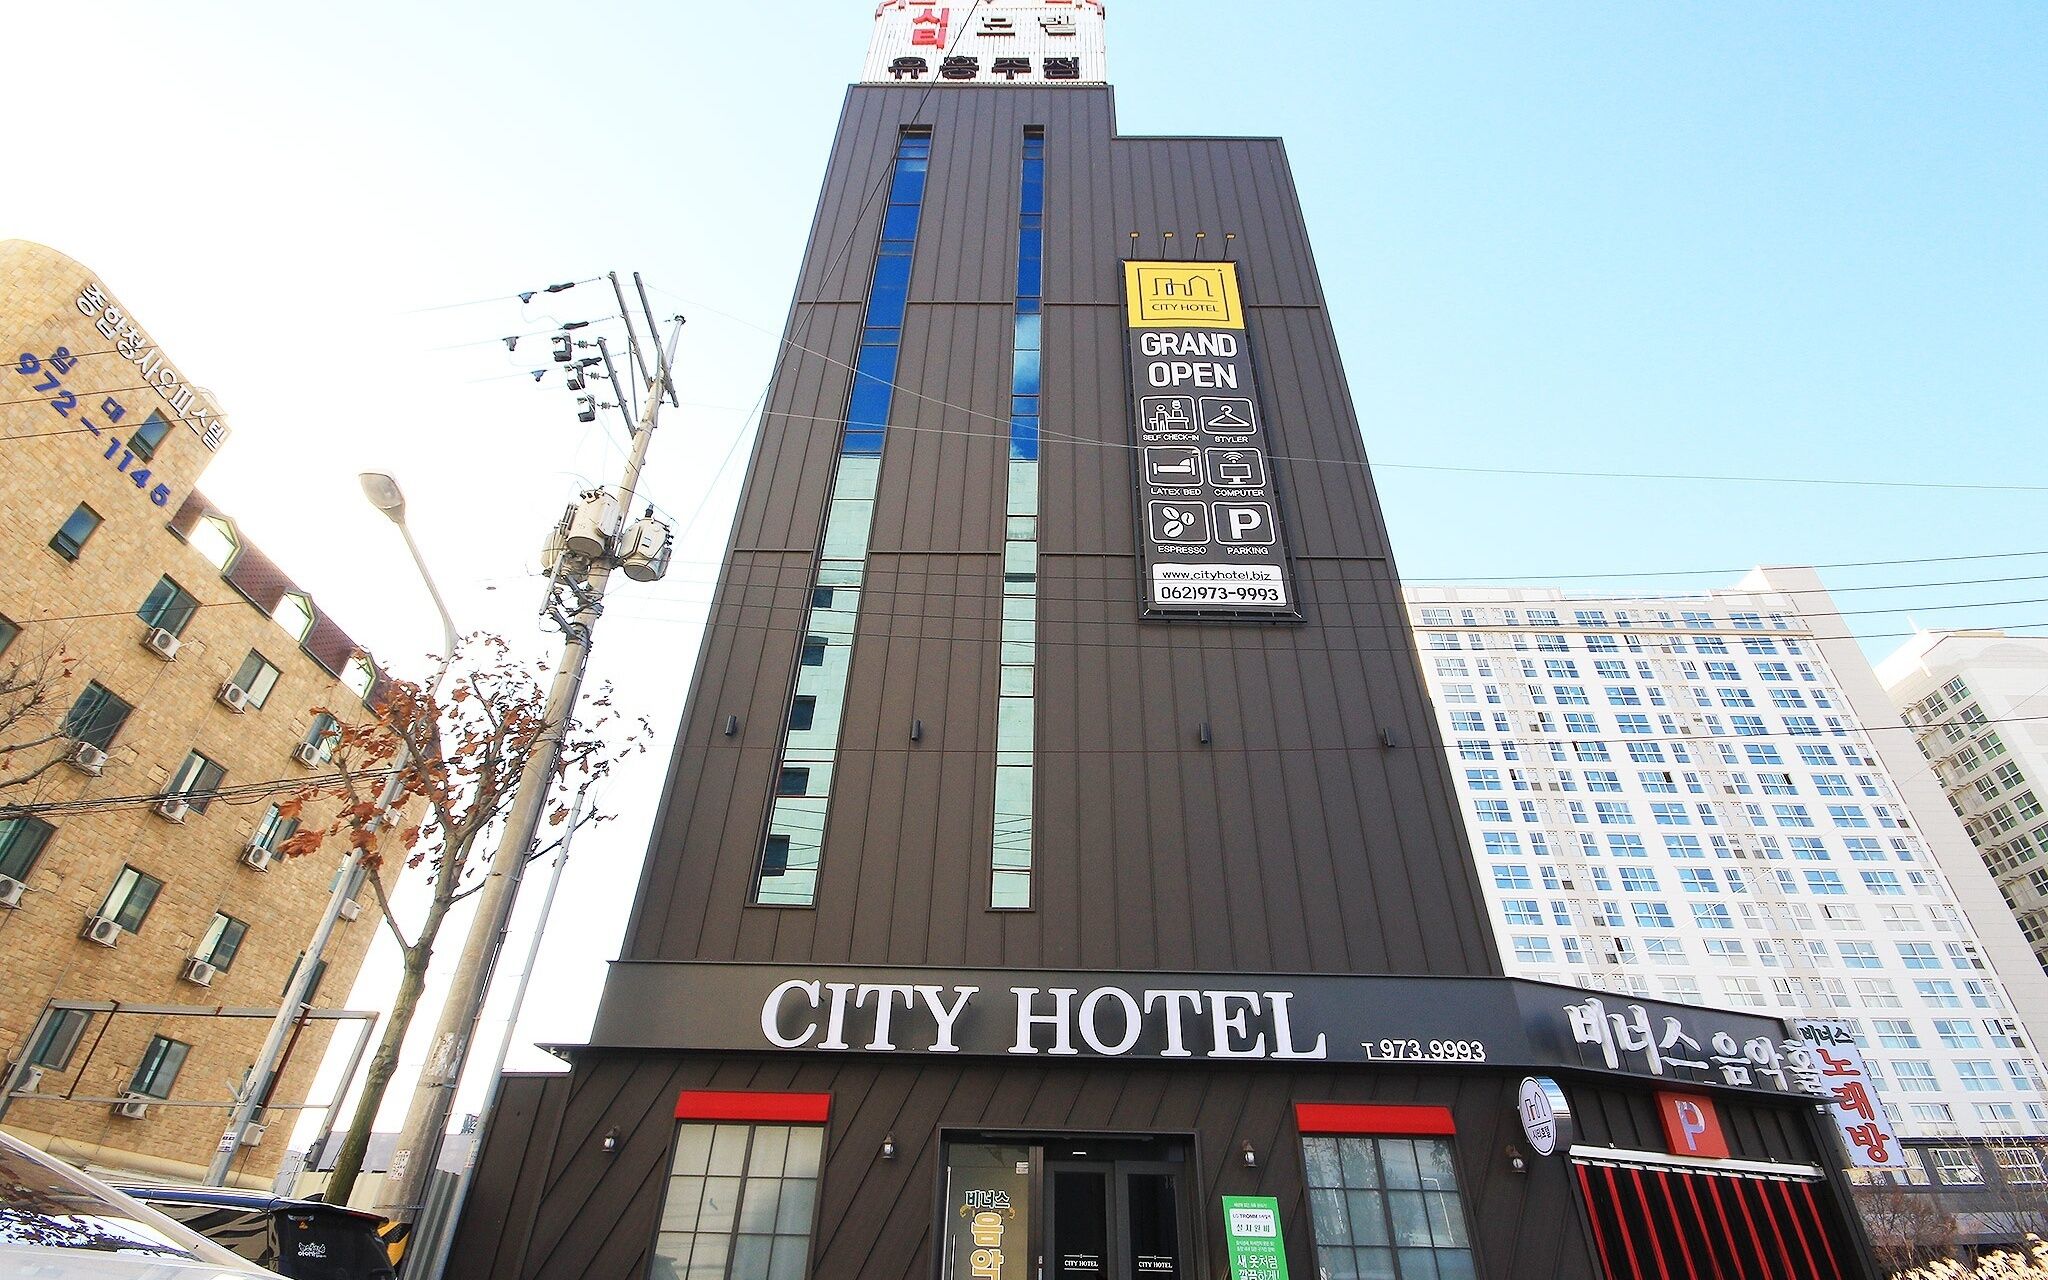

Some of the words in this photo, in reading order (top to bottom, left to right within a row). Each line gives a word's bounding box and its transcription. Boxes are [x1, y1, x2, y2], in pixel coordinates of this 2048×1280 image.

[888, 55, 1080, 80] 유흥주점
[1152, 303, 1177, 312] CITY
[1181, 304, 1220, 313] HOTEL
[1140, 332, 1239, 358] GRAND
[76, 282, 225, 453] 종합청사오피스텔
[1148, 361, 1239, 390] OPEN
[49, 346, 78, 376] 임
[101, 395, 127, 424] 대
[1142, 434, 1162, 442] SELF
[1163, 434, 1200, 442] CHECK-IN
[1214, 436, 1249, 444] STYLER
[1150, 488, 1181, 496] LATEX
[1214, 489, 1265, 497] COMPUTER
[1228, 508, 1263, 540] P
[1157, 545, 1207, 555] ESPRESSO
[1226, 546, 1269, 556] PARKING
[1162, 570, 1272, 582] www.cityhotel.biz
[1161, 586, 1279, 601] 062)973-9993
[760, 979, 980, 1052] CITY
[1008, 986, 1328, 1060] HOTEL
[1800, 1024, 1854, 1047] 비너스
[1379, 1038, 1487, 1062] 973.9993
[1563, 996, 1709, 1076] 비너스
[1709, 1031, 1828, 1098] 음악홀
[1815, 1048, 1891, 1163] 노래방
[1674, 1099, 1706, 1152] P
[965, 1190, 1011, 1209] 비너스
[1153, 1261, 1173, 1269] HOTEL
[1237, 1254, 1247, 1269] 새
[1249, 1254, 1278, 1269] 옷처럼
